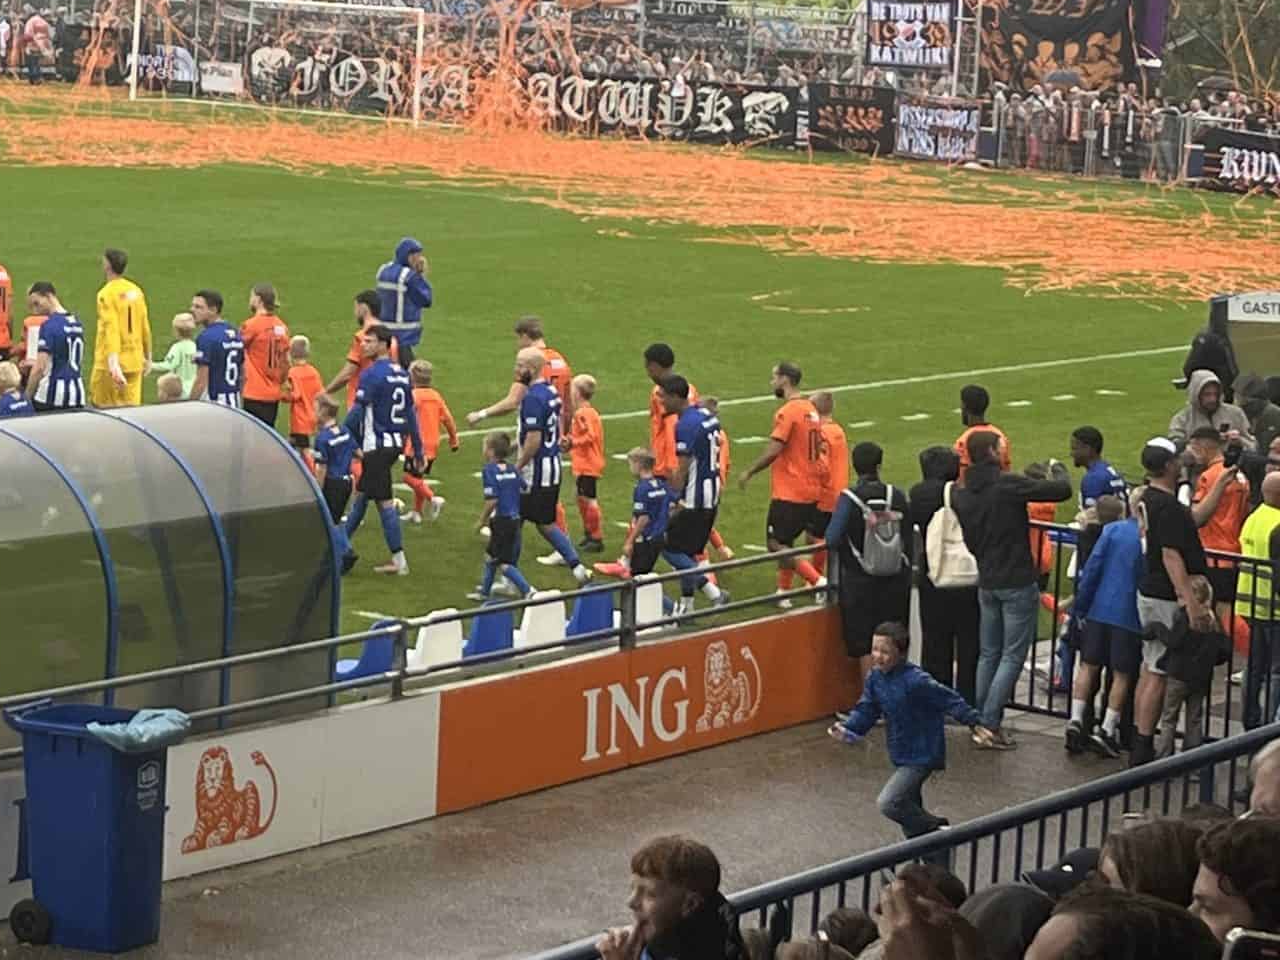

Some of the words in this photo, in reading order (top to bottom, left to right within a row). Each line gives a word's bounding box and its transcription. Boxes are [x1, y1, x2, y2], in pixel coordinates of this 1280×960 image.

[127, 304, 133, 334] 1
[1242, 301, 1280, 315] GAST
[66, 336, 84, 372] 10
[224, 349, 238, 386] 6
[390, 387, 405, 424] 2
[581, 666, 691, 762] ING
